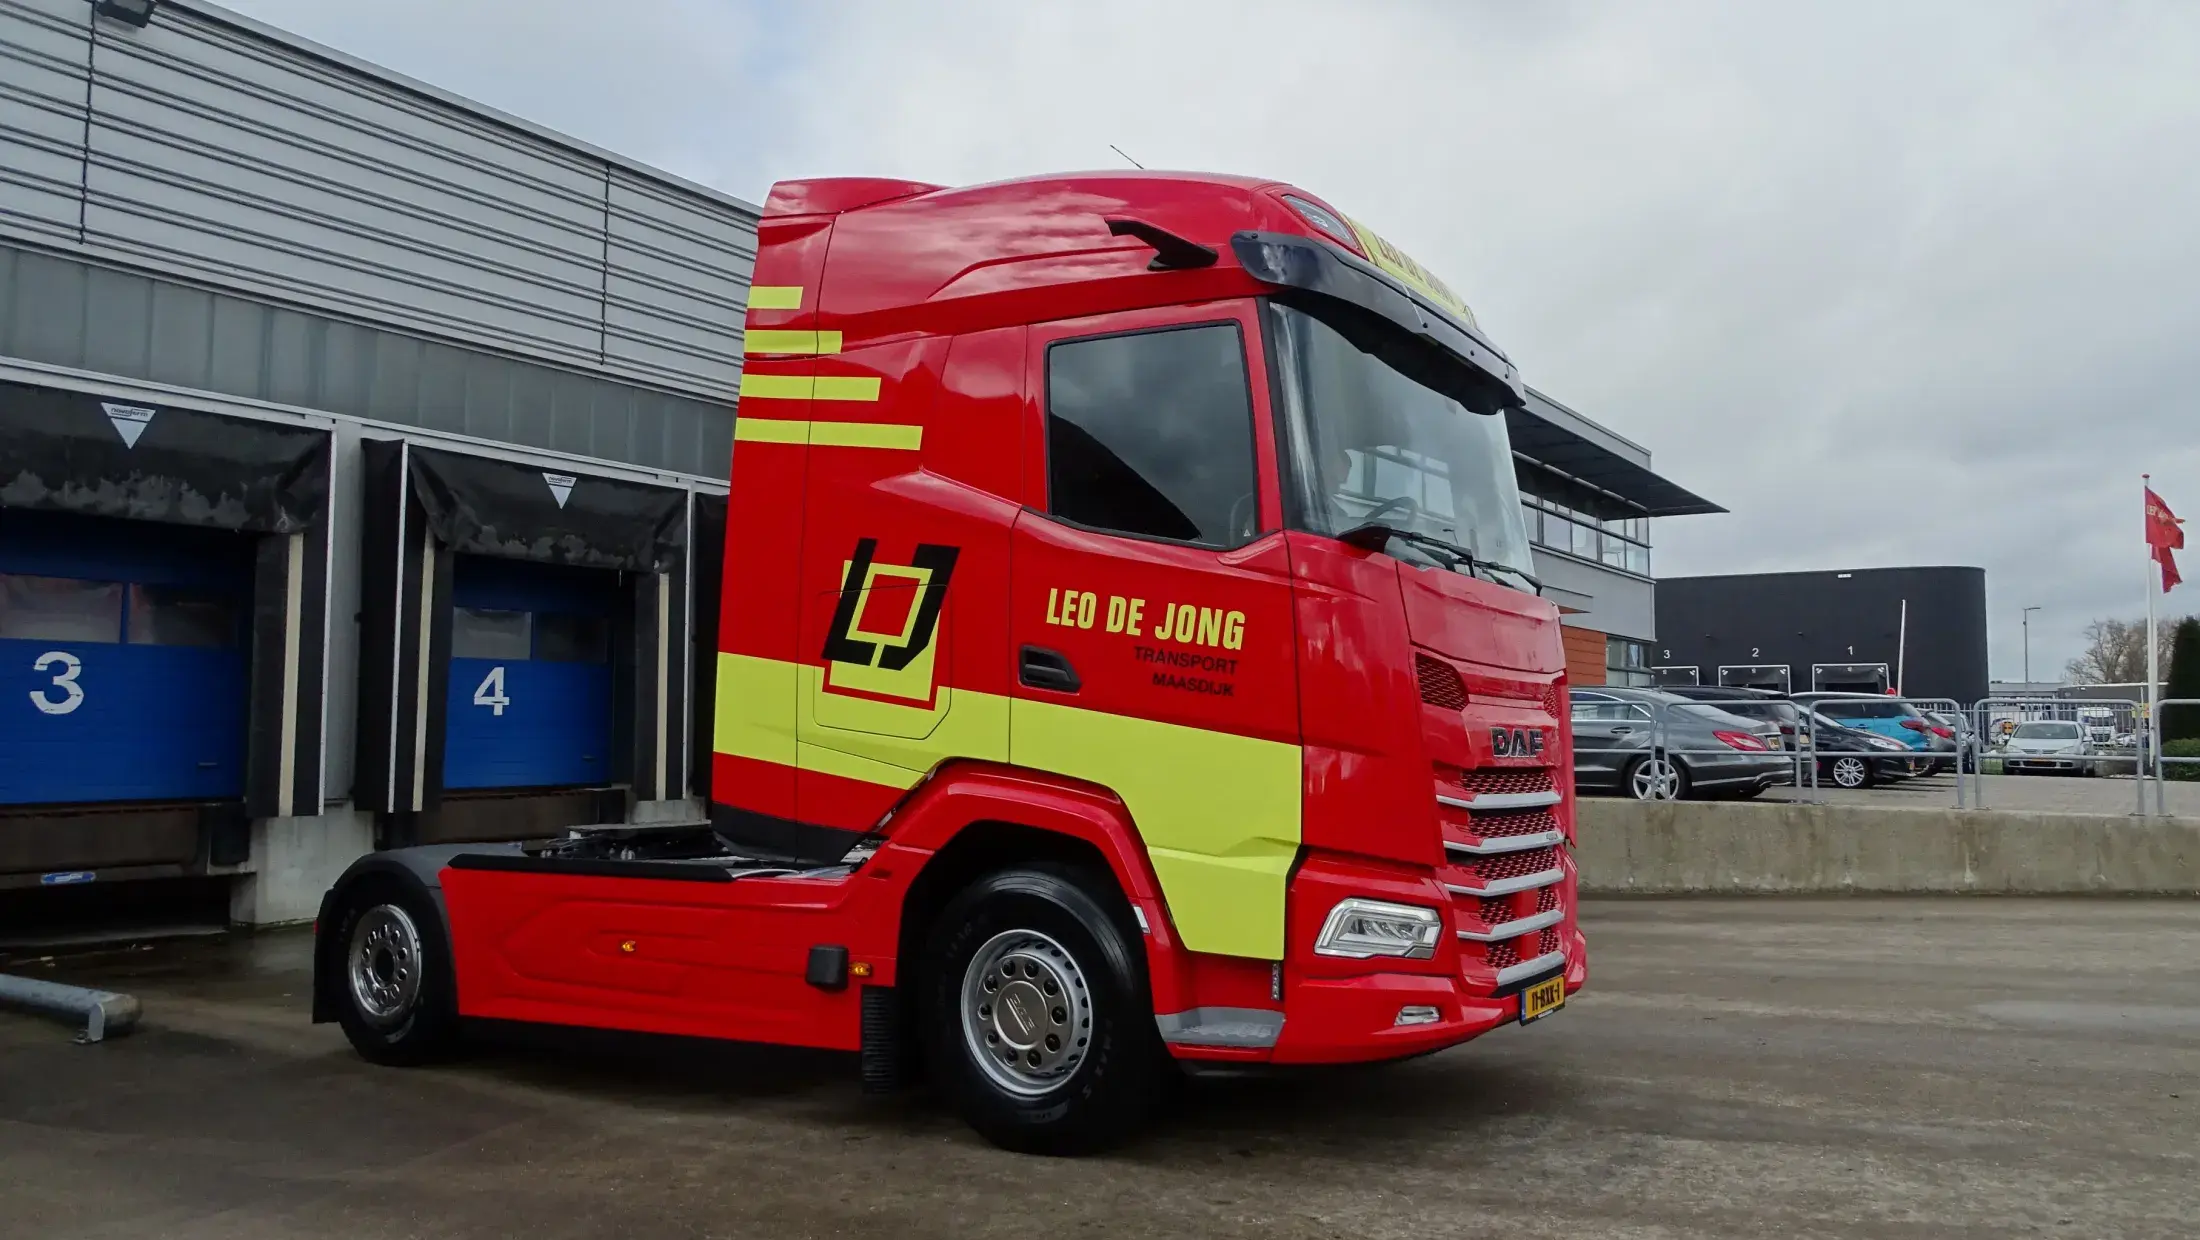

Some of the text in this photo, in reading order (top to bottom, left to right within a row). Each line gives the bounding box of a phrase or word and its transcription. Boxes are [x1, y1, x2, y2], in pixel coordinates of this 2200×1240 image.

[1046, 587, 1246, 651] LEO DE JONG
[1134, 645, 1238, 676] TRANSPORT
[1663, 649, 1671, 659] 3
[1752, 647, 1760, 658] 2
[1847, 645, 1854, 656] 1
[29, 651, 84, 715] 3
[473, 666, 510, 716] 4
[1152, 672, 1235, 697] MAASDIJK
[1490, 727, 1544, 758] DAF
